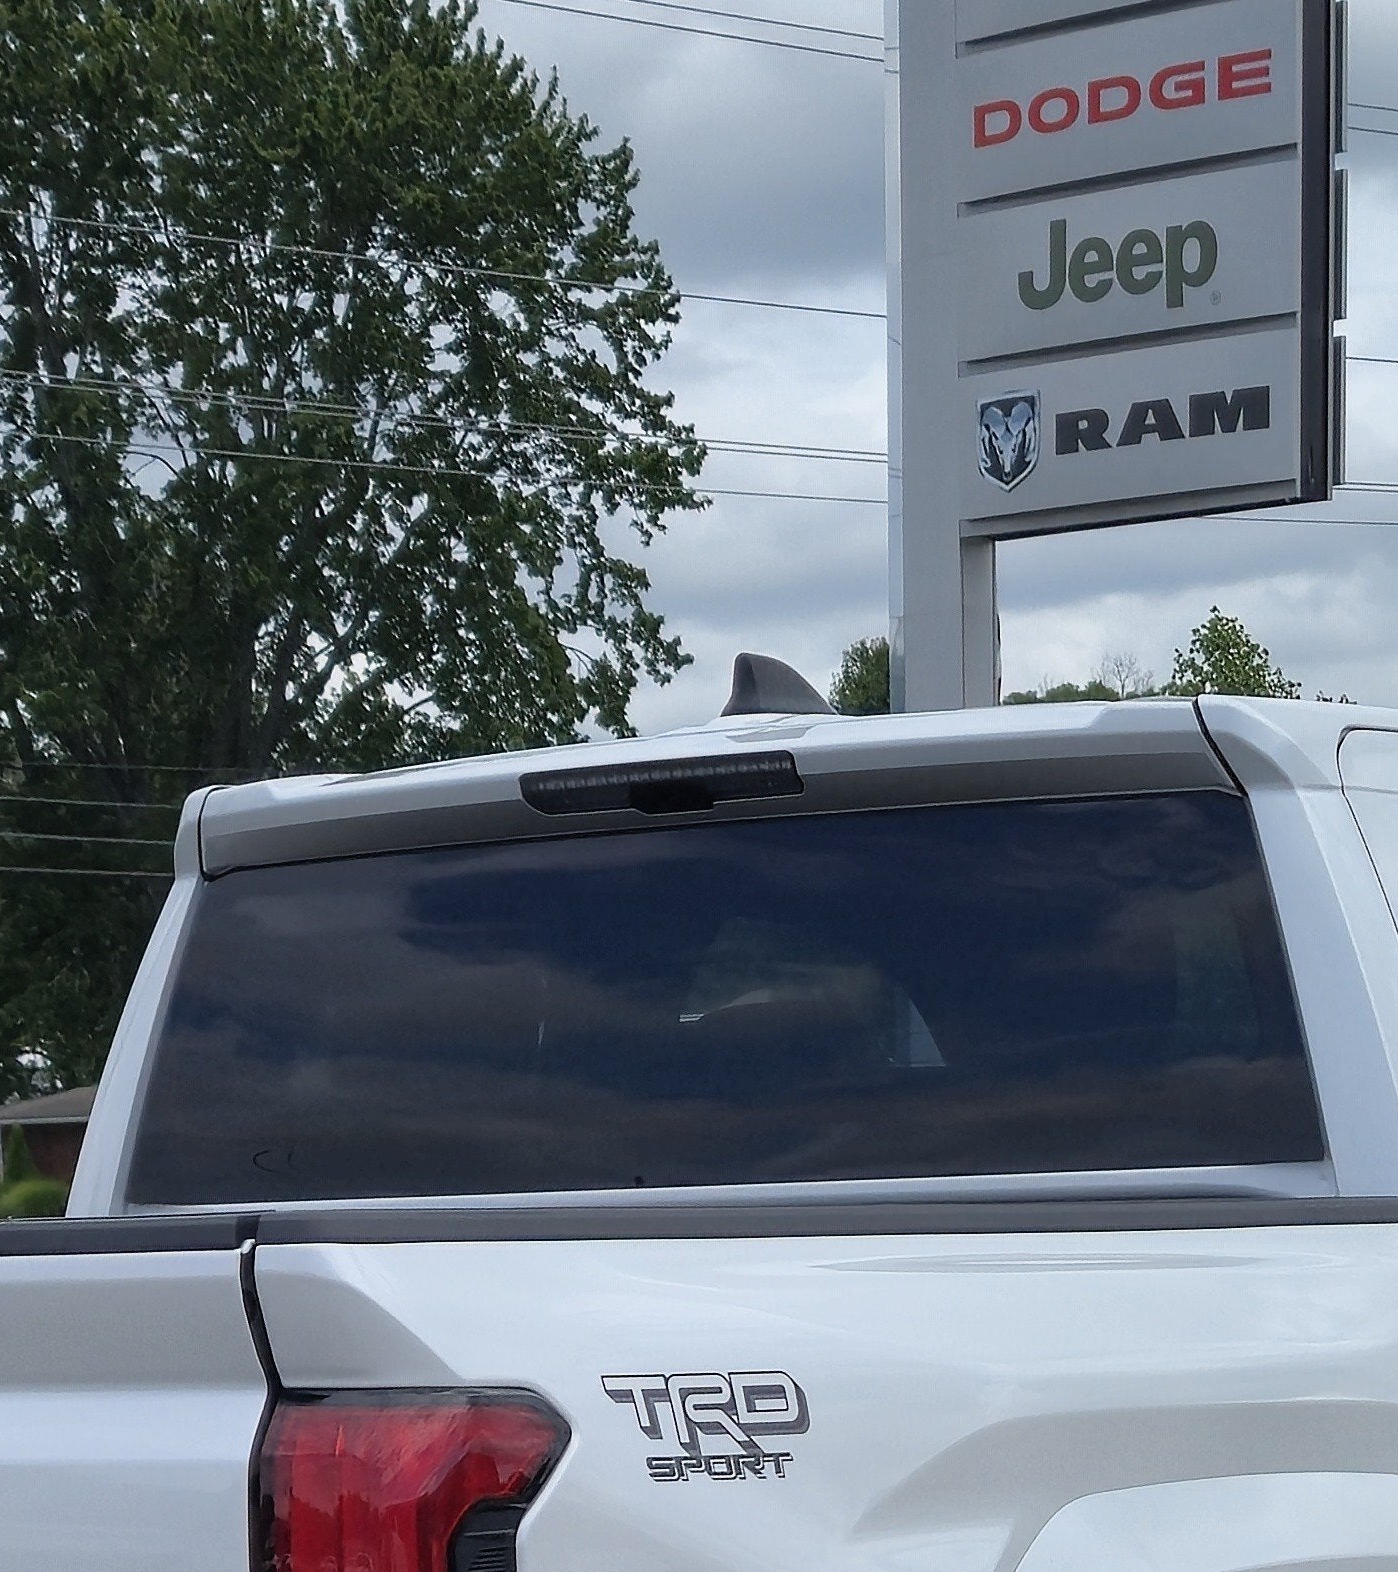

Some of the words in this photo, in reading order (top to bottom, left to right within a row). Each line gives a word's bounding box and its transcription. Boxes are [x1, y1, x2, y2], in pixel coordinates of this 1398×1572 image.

[974, 49, 1272, 148] DODGE
[1018, 218, 1218, 310] Jeep
[1055, 385, 1270, 455] RAM
[601, 1371, 811, 1457] TRD
[646, 1452, 794, 1482] SPORT
